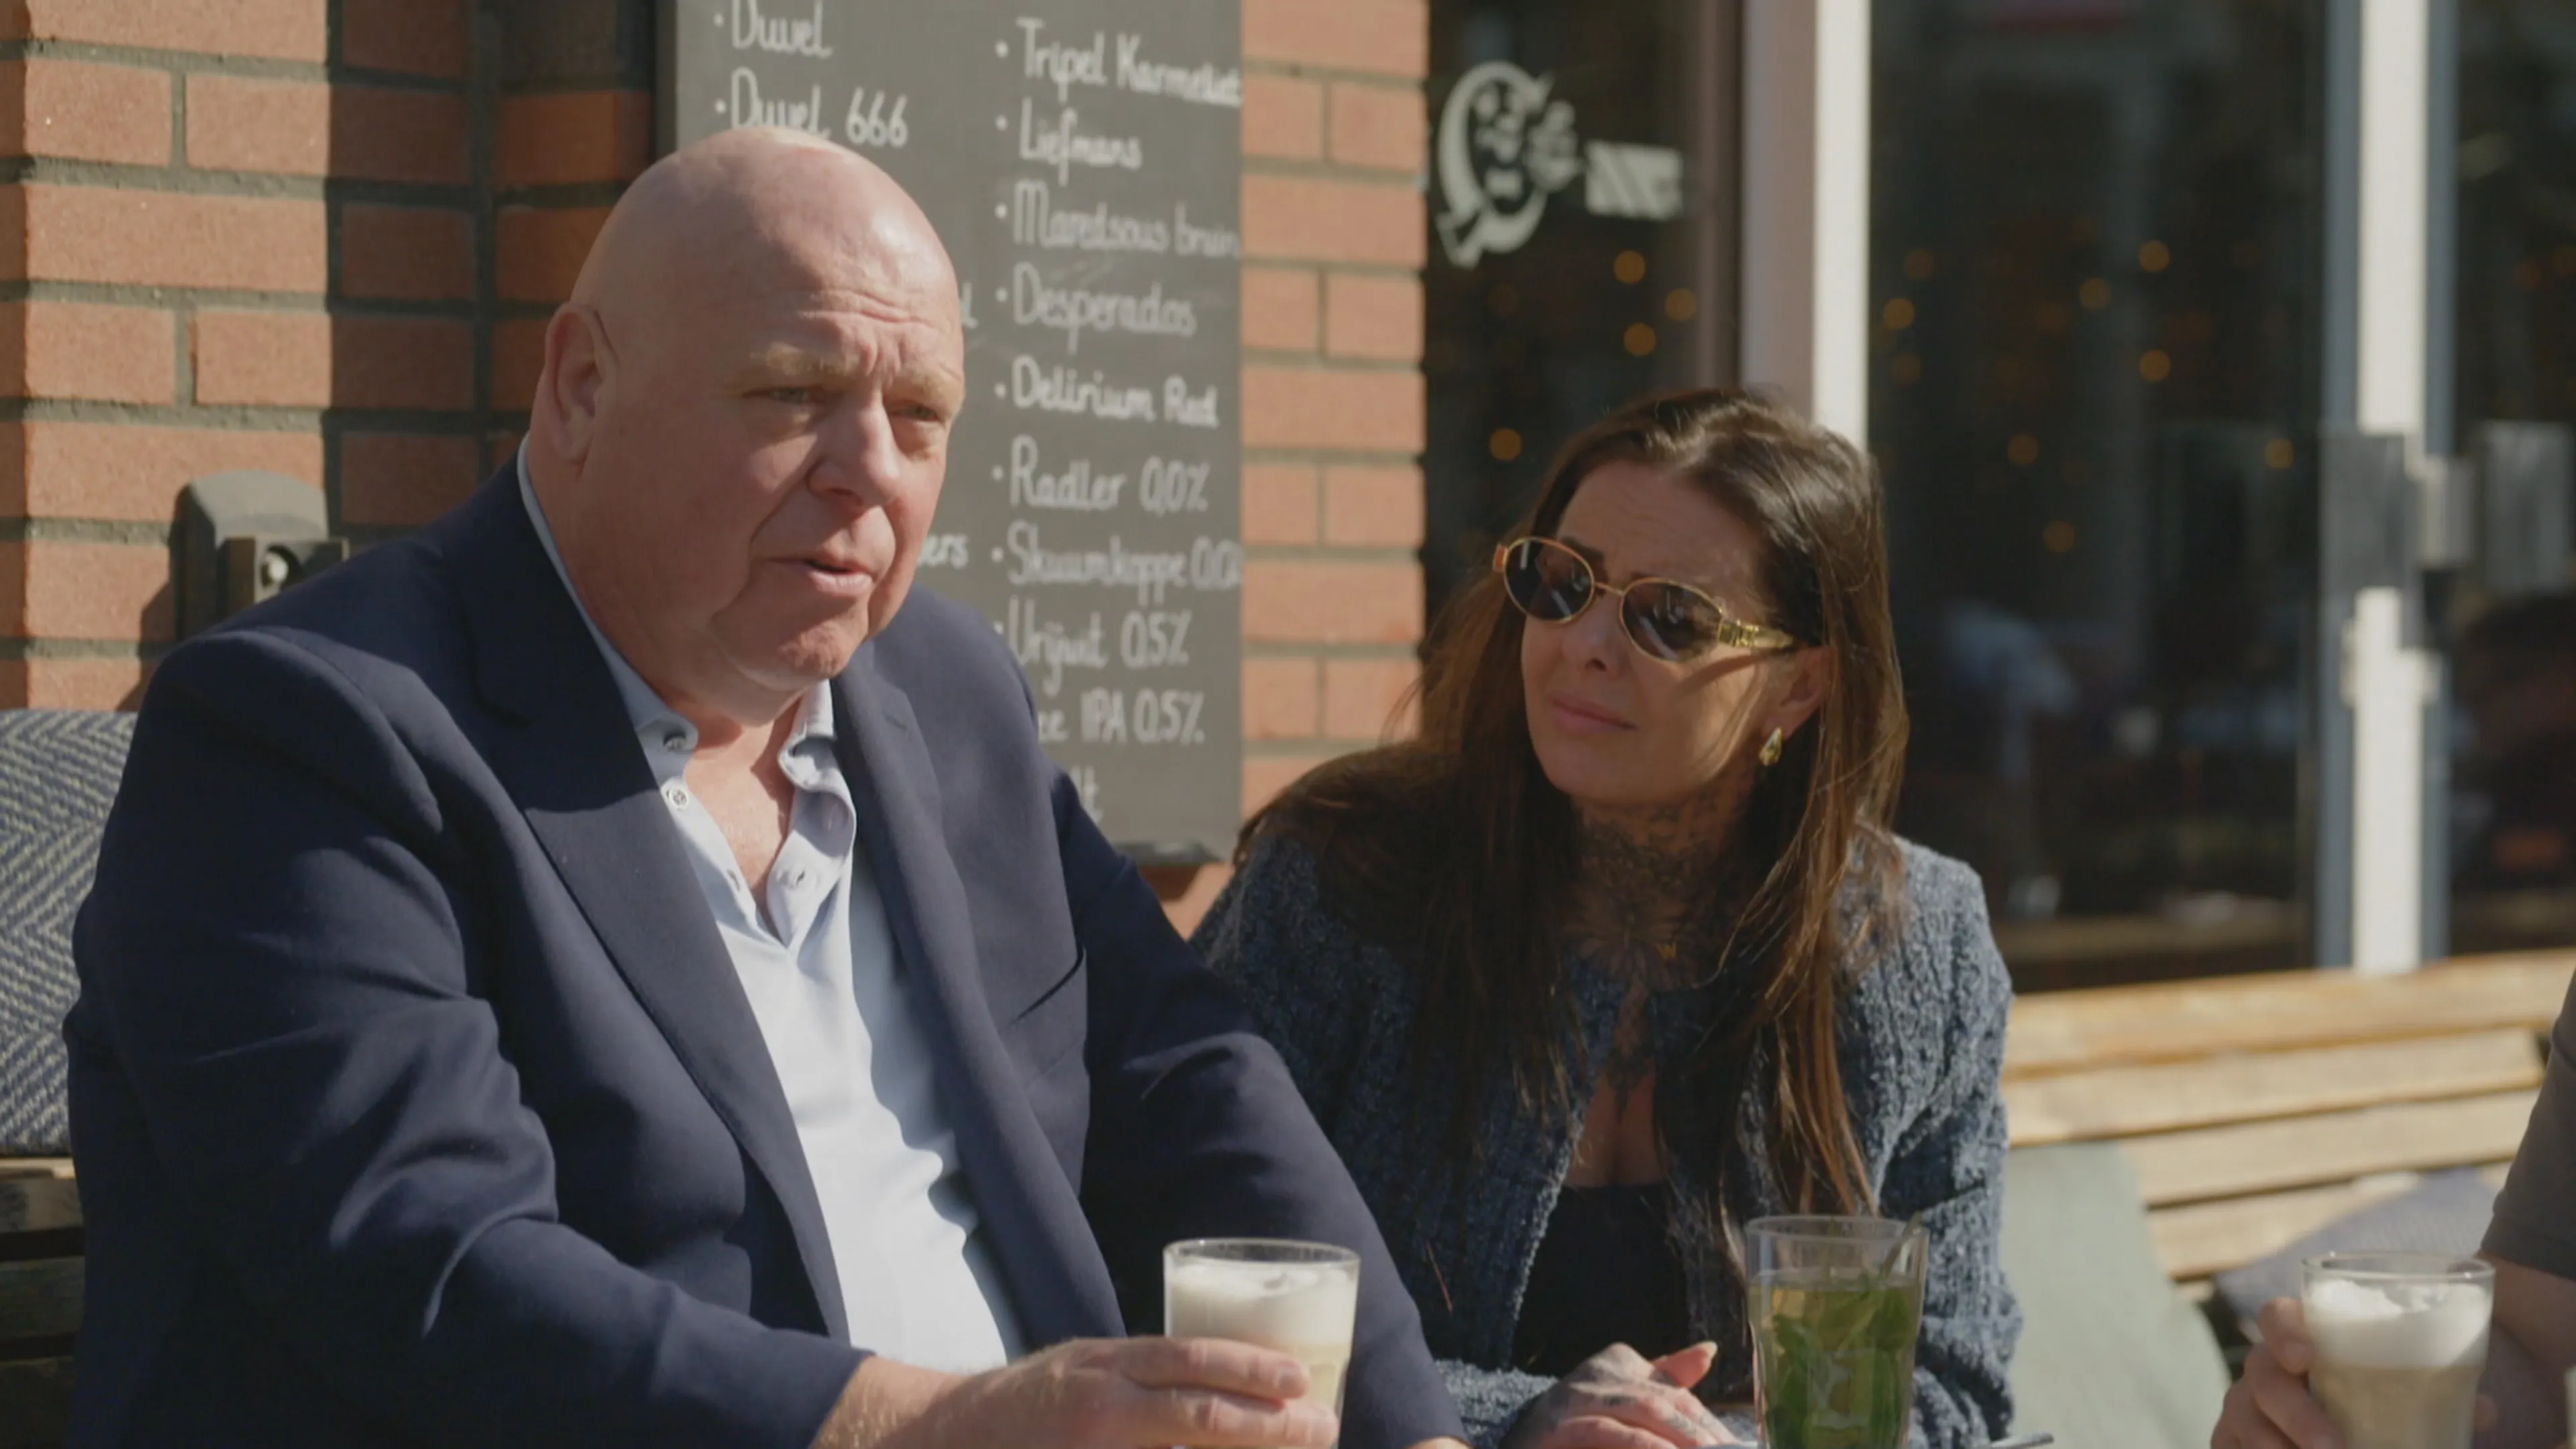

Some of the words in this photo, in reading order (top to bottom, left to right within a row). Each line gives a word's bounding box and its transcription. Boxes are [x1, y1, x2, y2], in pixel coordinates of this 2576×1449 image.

[732, 0, 833, 57] Duvel
[1015, 16, 1107, 104] Tripel
[732, 66, 830, 140] Duvel
[845, 87, 908, 148] 666
[1020, 96, 1142, 187] Liefmans
[1013, 262, 1197, 354] Desperados
[1012, 356, 1157, 423] Delirium
[1164, 374, 1220, 429] Red
[1010, 434, 1128, 511] Radler
[1081, 687, 1128, 745] IPA
